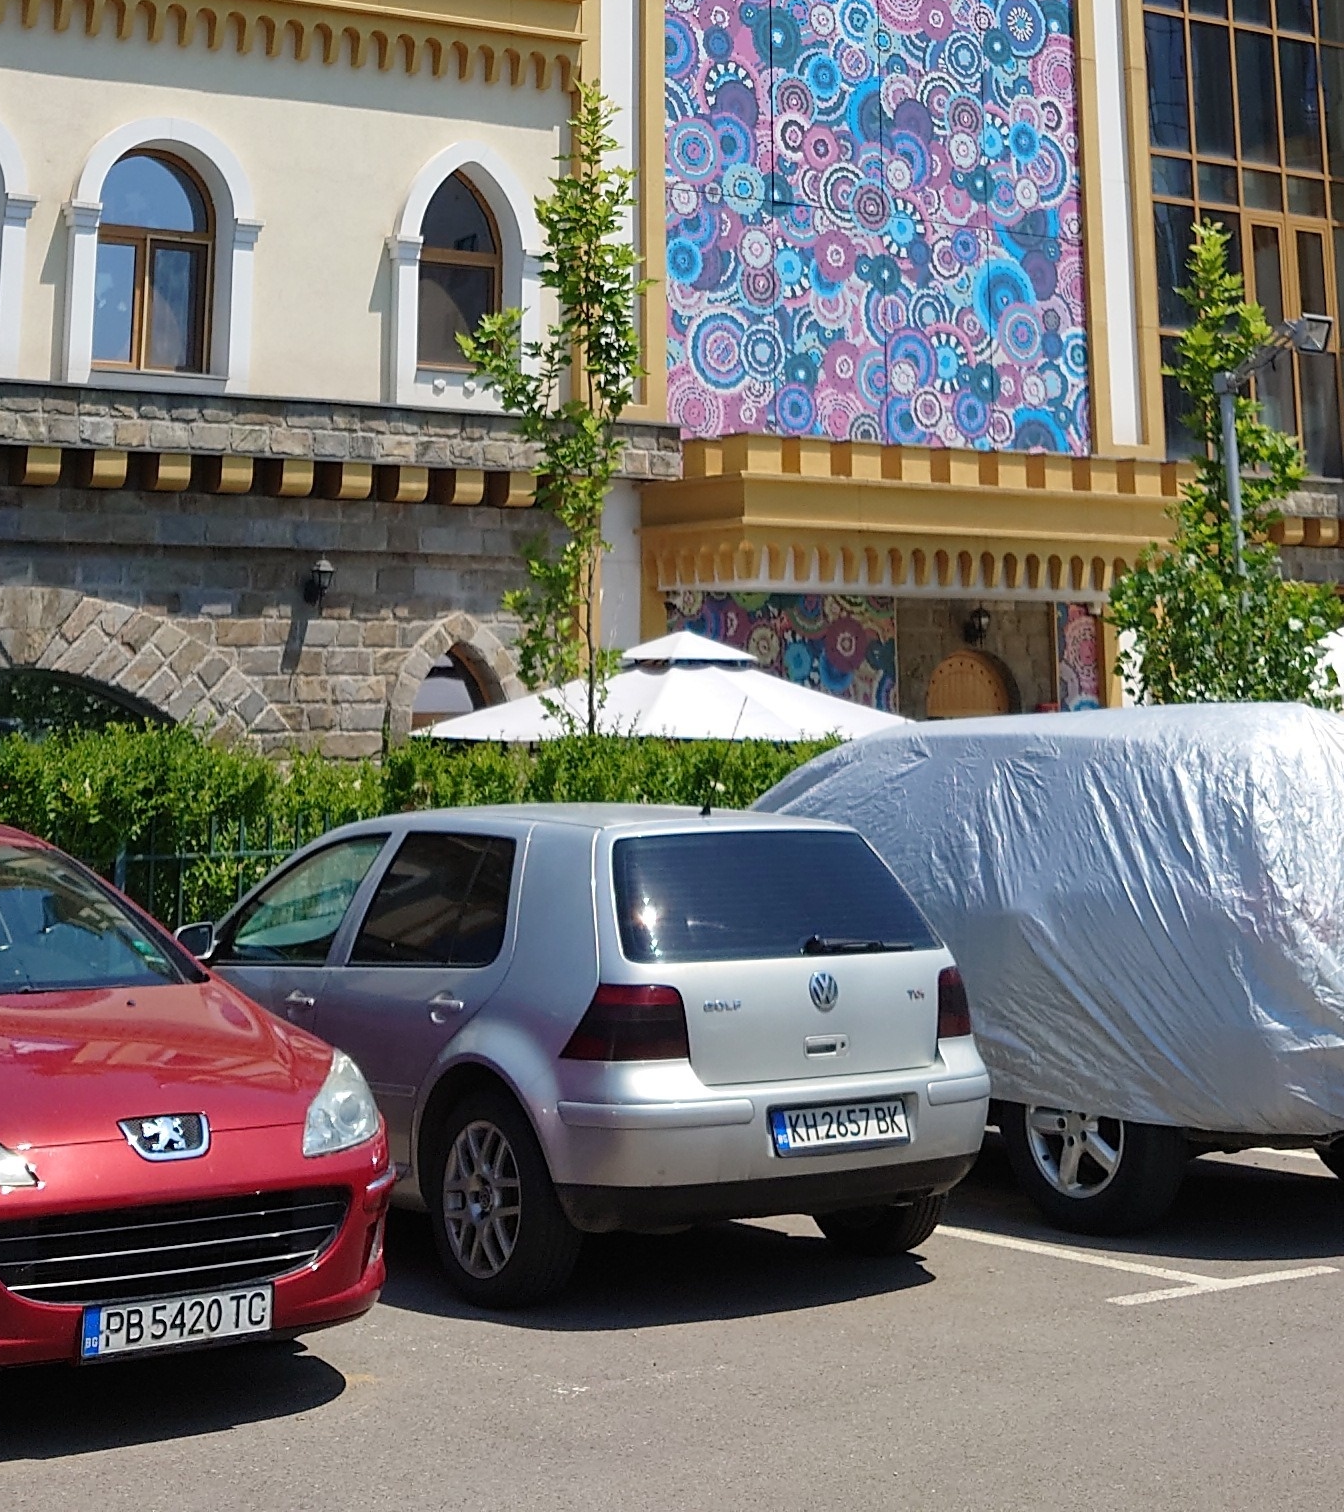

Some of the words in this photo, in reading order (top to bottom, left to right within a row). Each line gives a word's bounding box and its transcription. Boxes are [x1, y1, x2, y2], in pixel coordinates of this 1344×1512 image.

[703, 999, 741, 1013] GOLF
[151, 1298, 223, 1340] 5420
[229, 1291, 266, 1328] TC
[85, 1337, 99, 1348] BG
